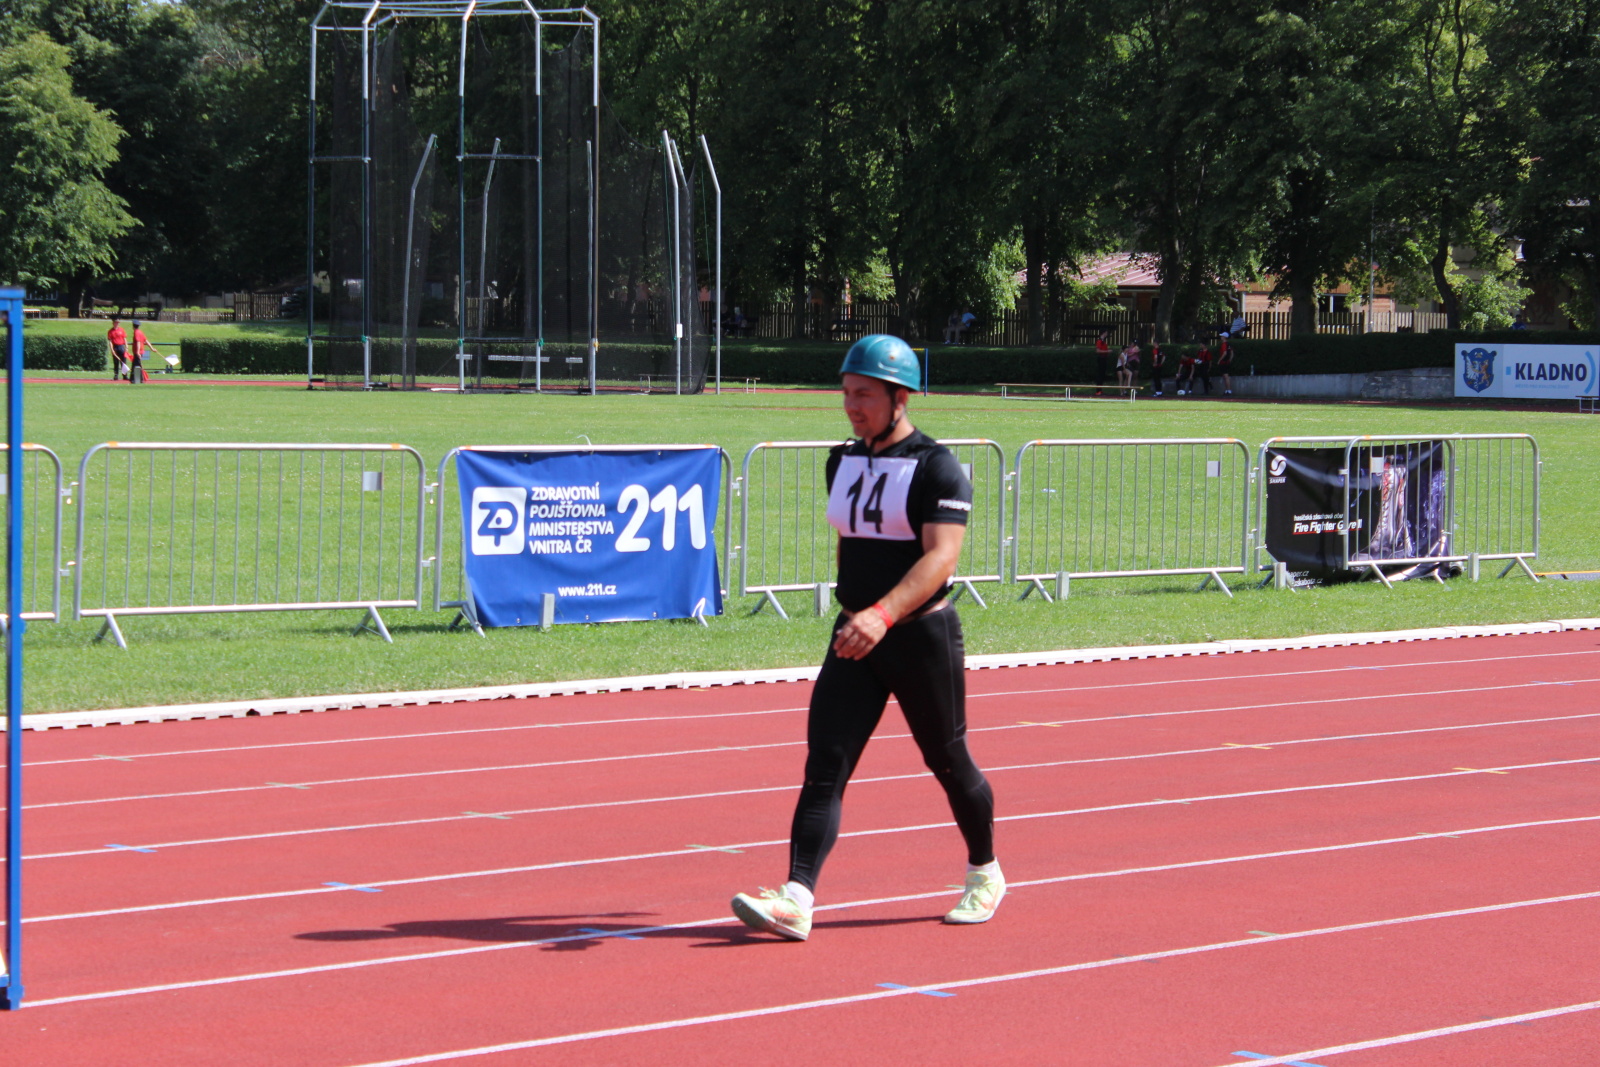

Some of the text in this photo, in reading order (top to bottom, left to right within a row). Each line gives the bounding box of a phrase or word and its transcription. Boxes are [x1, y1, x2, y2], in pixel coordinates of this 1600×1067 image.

[1515, 363, 1587, 381] KLADNO
[531, 482, 600, 501] ZDRAVOTNÍ
[529, 500, 606, 518] POJIŠŤOVNA
[846, 470, 889, 534] 14
[615, 483, 706, 552] 211
[529, 520, 614, 537] MINISTERSTVA
[1294, 522, 1309, 532] Fire
[1310, 521, 1336, 533] Fighter
[529, 535, 592, 554] VNITRA ČR
[558, 583, 617, 597] www.211.cz
